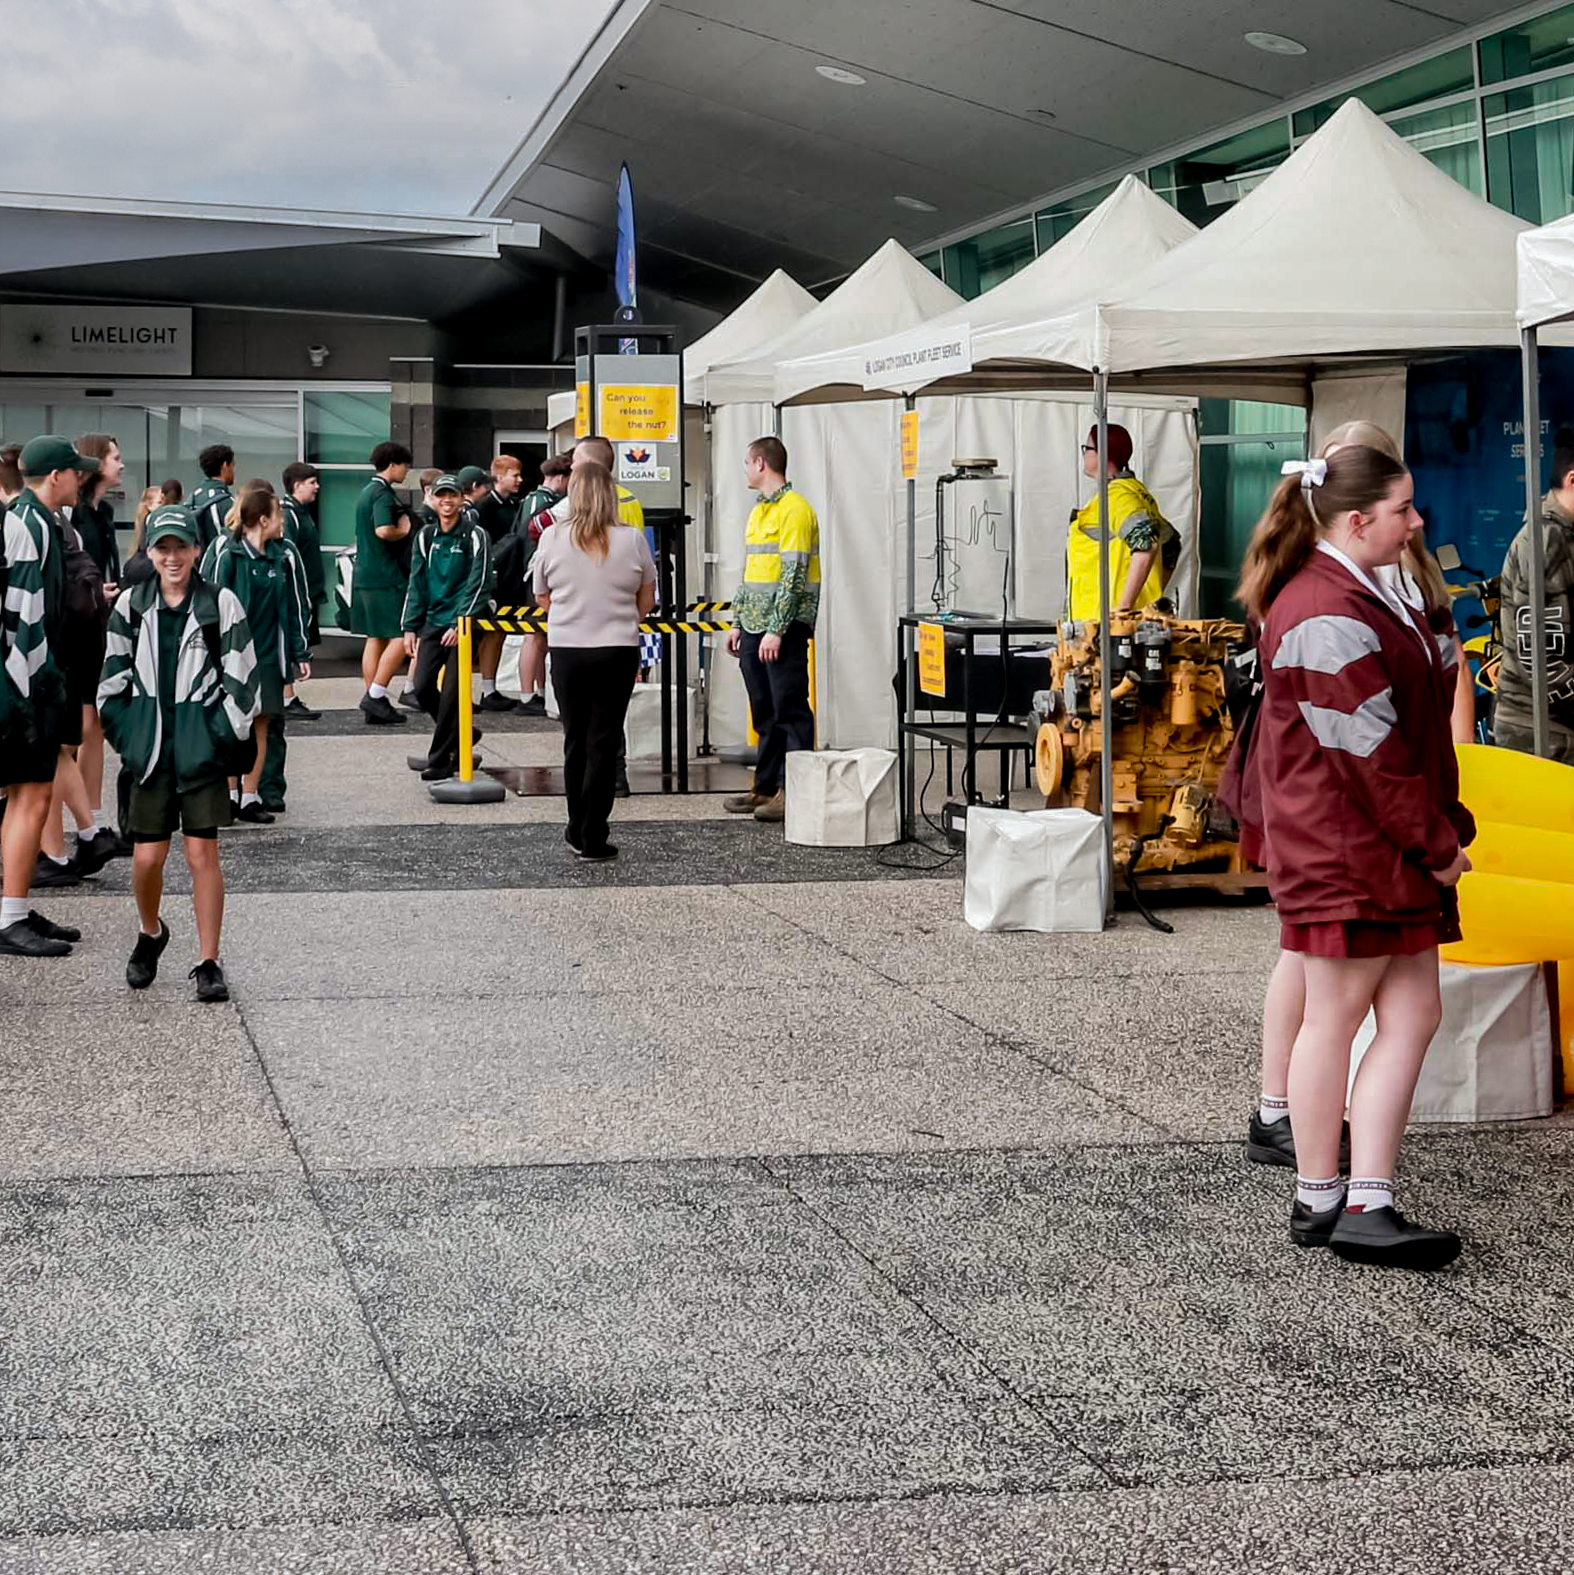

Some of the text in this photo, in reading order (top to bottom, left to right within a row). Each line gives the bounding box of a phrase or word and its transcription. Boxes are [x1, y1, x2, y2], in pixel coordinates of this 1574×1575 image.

[71, 327, 177, 344] LIMELIGHT
[606, 393, 646, 403] Can you
[619, 406, 654, 416] release
[628, 420, 667, 429] the nut?
[1504, 421, 1527, 436] PLAN
[621, 471, 655, 479] LOGAN
